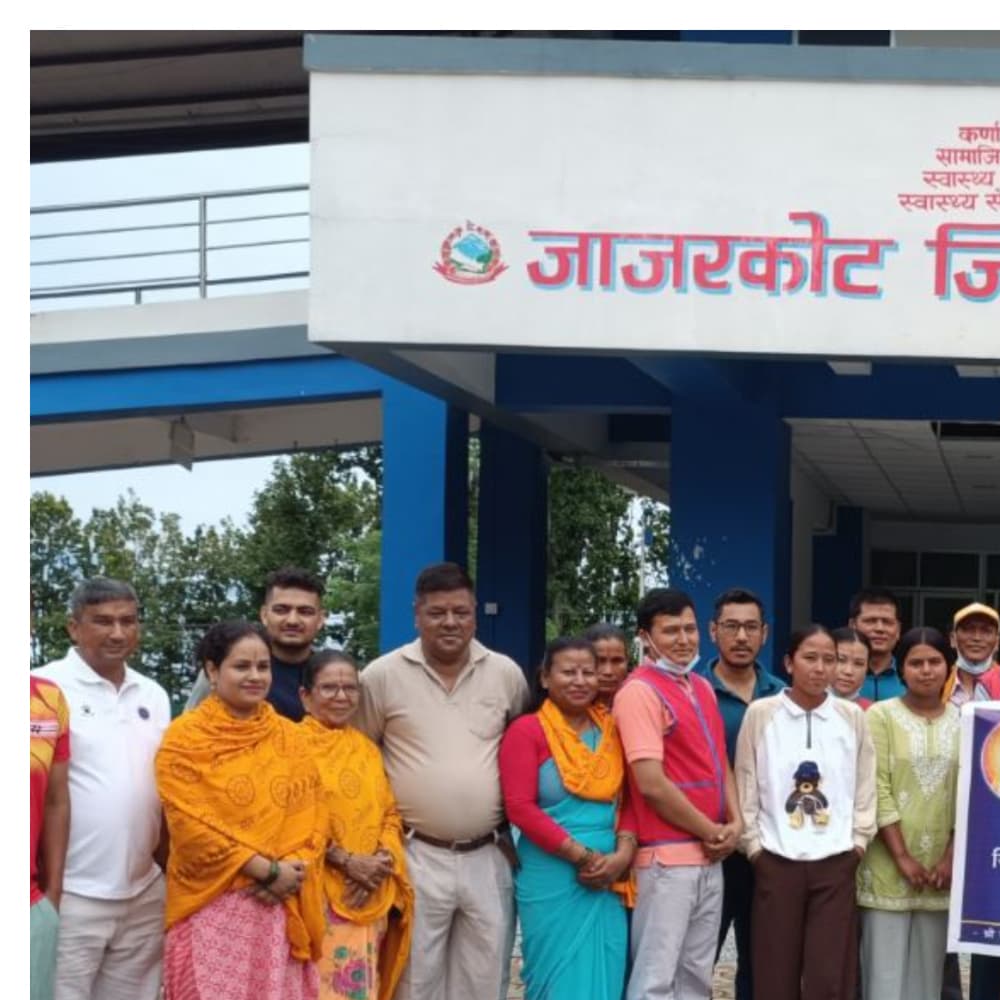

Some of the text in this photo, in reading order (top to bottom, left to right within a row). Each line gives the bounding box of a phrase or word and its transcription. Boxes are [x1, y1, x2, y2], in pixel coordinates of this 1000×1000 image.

[922, 171, 995, 188] स्वास्थ्य
[898, 193, 978, 212] स्वास्थ्य
[526, 212, 899, 299] जाजरकोट
